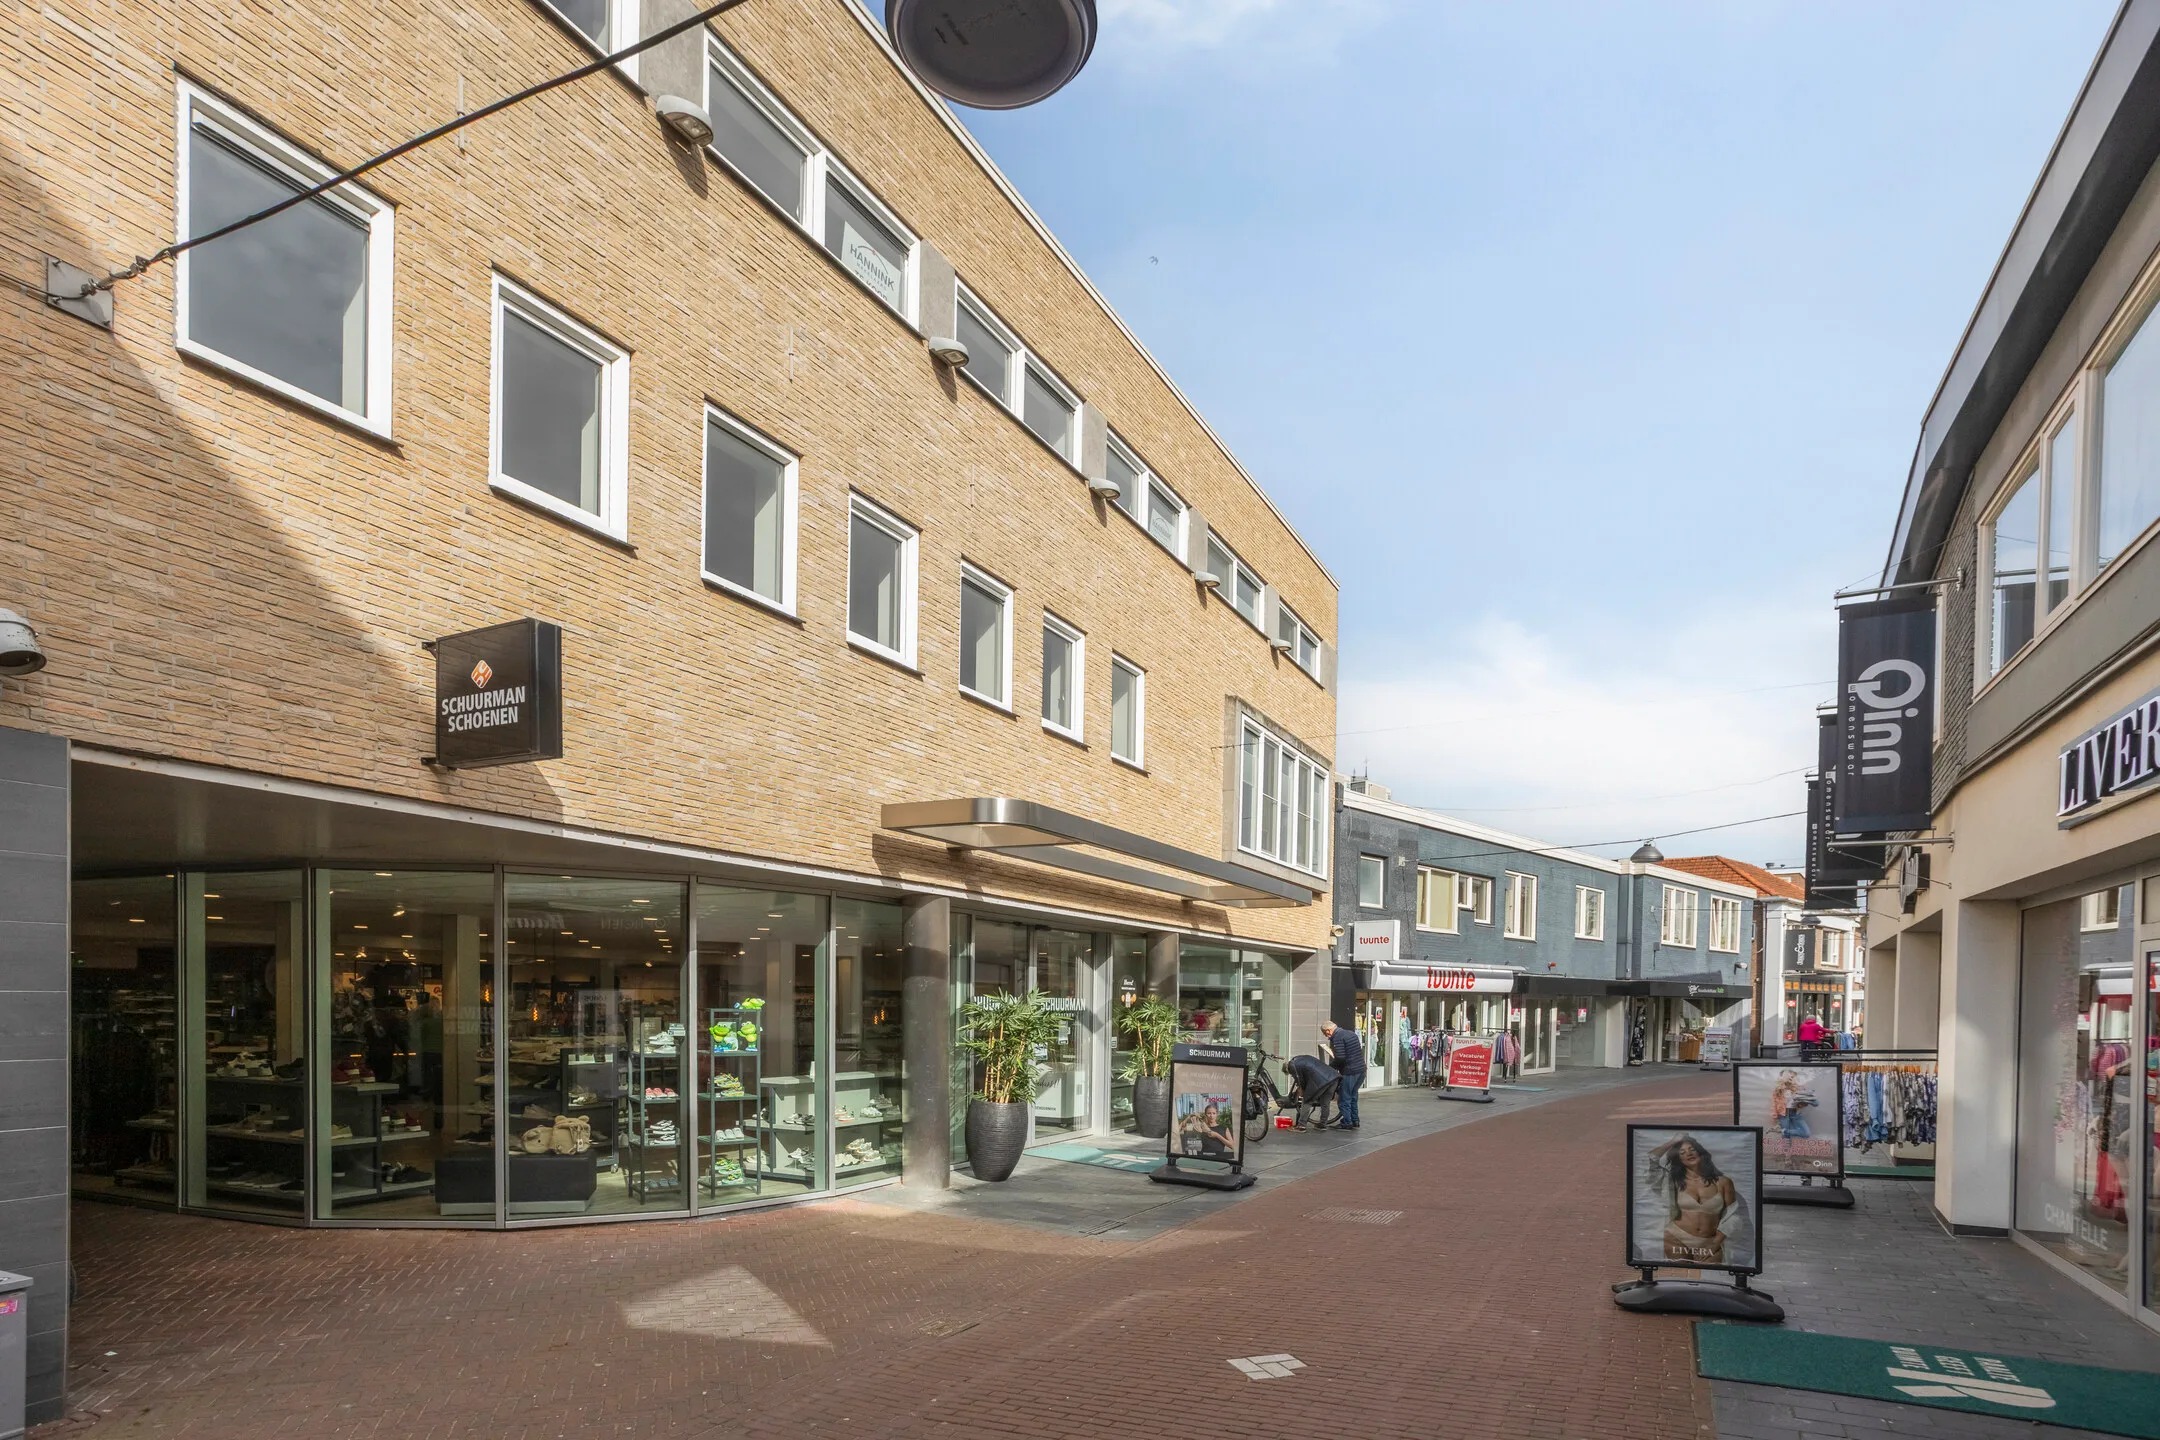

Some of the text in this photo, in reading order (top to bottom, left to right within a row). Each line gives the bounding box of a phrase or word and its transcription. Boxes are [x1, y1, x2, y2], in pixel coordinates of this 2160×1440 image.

[850, 244, 894, 291] HANNINK
[441, 685, 526, 716] SCHUURMAN
[448, 706, 519, 733] SCHOENEN
[1856, 659, 1926, 775] Qinn
[1848, 684, 1857, 776] womenswear
[1359, 936, 1390, 945] tuunte
[1427, 966, 1476, 990] tuunte
[1040, 997, 1086, 1011] SCHUURMAN
[1189, 1049, 1231, 1059] SCHUURMAN
[1813, 1160, 1833, 1168] Qinn
[2044, 1203, 2108, 1251] CHANTELLE
[1672, 1246, 1715, 1257] LIVERA
[1889, 1346, 1930, 1370] RUIMTE
[1934, 1355, 1975, 1376] GEEFT
[1973, 1356, 2021, 1383] RAALTE
